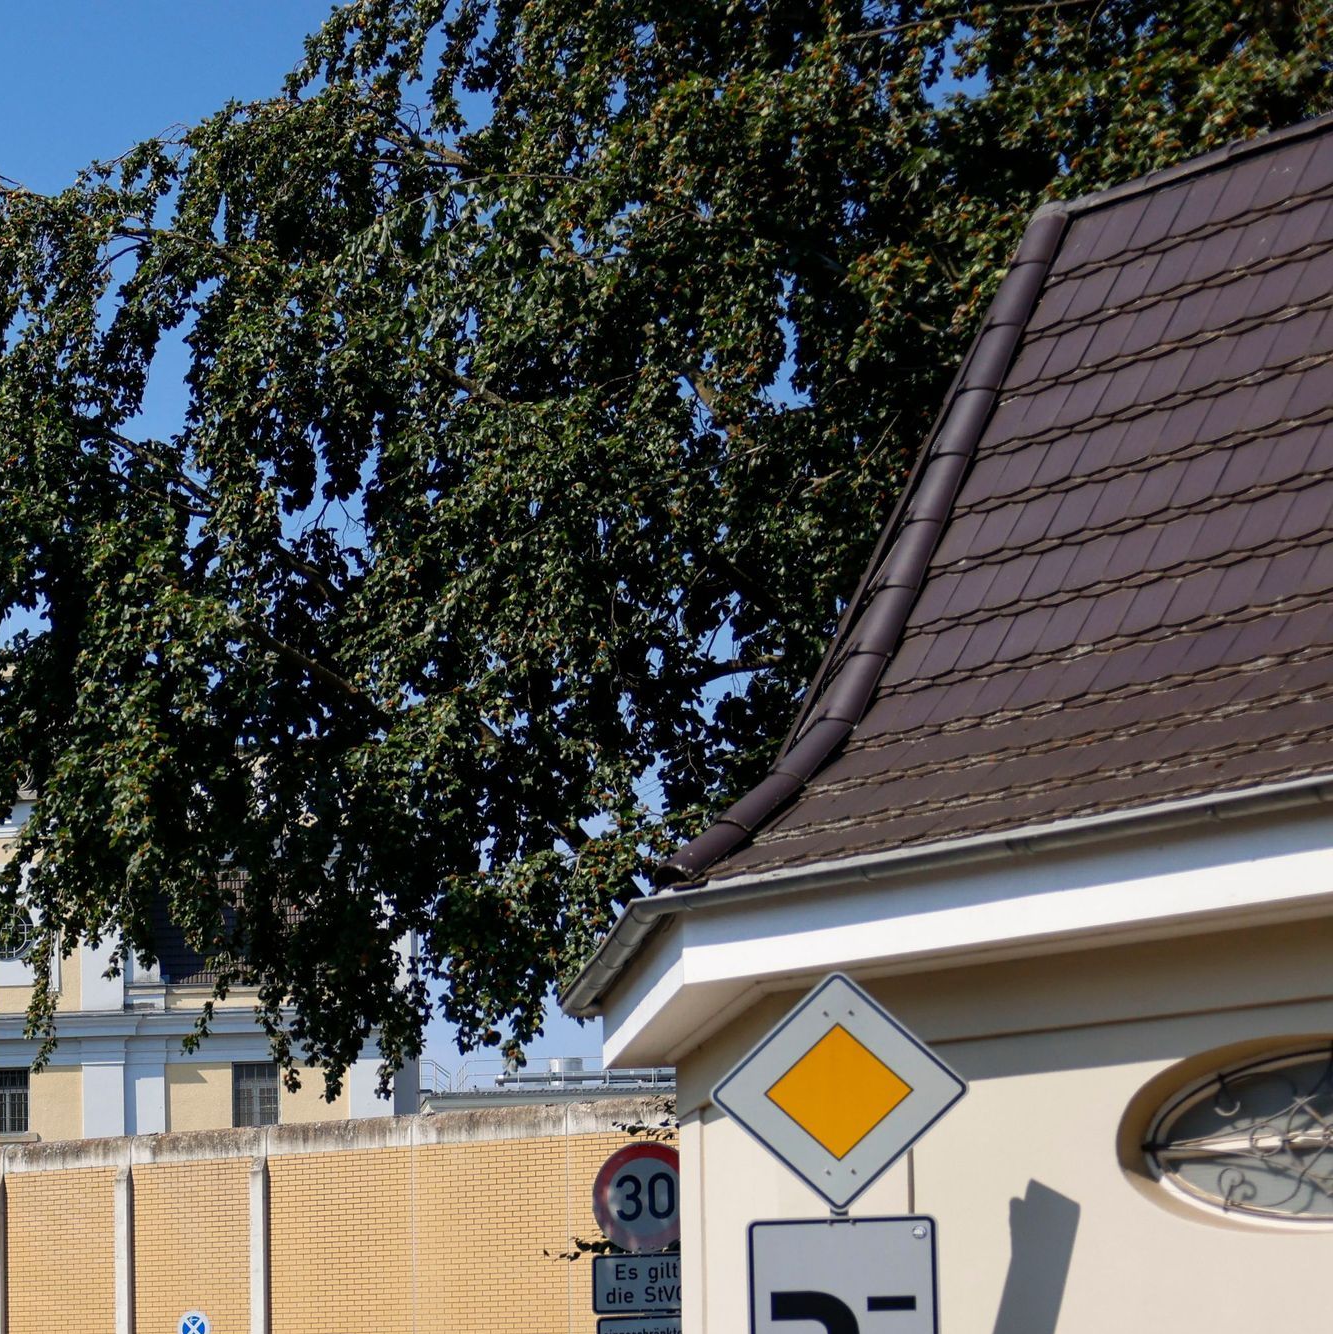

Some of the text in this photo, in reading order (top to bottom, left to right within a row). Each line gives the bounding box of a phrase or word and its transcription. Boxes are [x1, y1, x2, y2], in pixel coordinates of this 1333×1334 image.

[616, 1172, 675, 1222] 30
[615, 1262, 678, 1284] Es gilt
[606, 1287, 634, 1304] die
